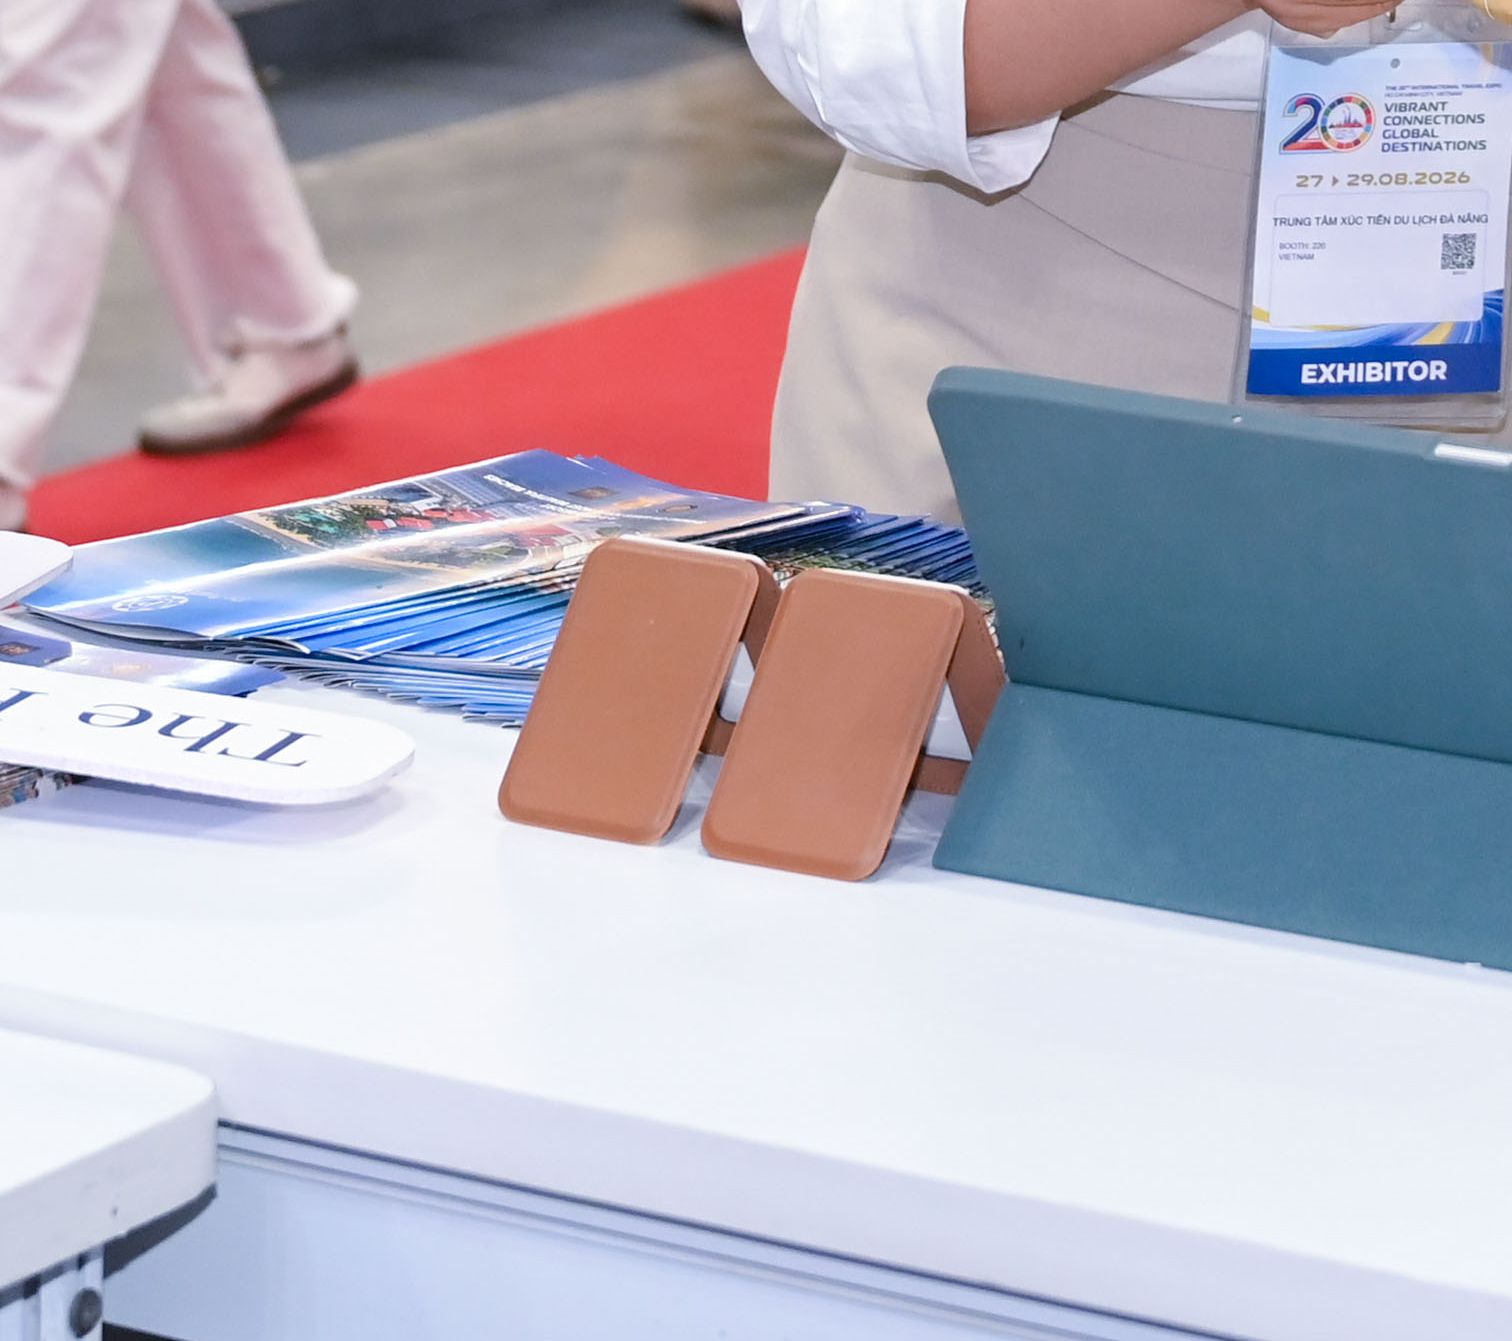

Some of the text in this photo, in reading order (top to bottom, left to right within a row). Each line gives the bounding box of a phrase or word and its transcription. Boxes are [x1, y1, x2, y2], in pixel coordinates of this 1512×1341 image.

[1384, 101, 1448, 113] VIBRANT
[1383, 114, 1485, 126] CONNECTIONS
[1382, 128, 1438, 139] GLOBAL
[1381, 140, 1487, 153] DESTINATIONS
[1296, 171, 1471, 188] 27 29.08.2026
[1273, 217, 1312, 227] TRUNG
[1394, 215, 1410, 225] DU
[1300, 359, 1448, 385] EXHIBITOR
[78, 701, 323, 769] The
